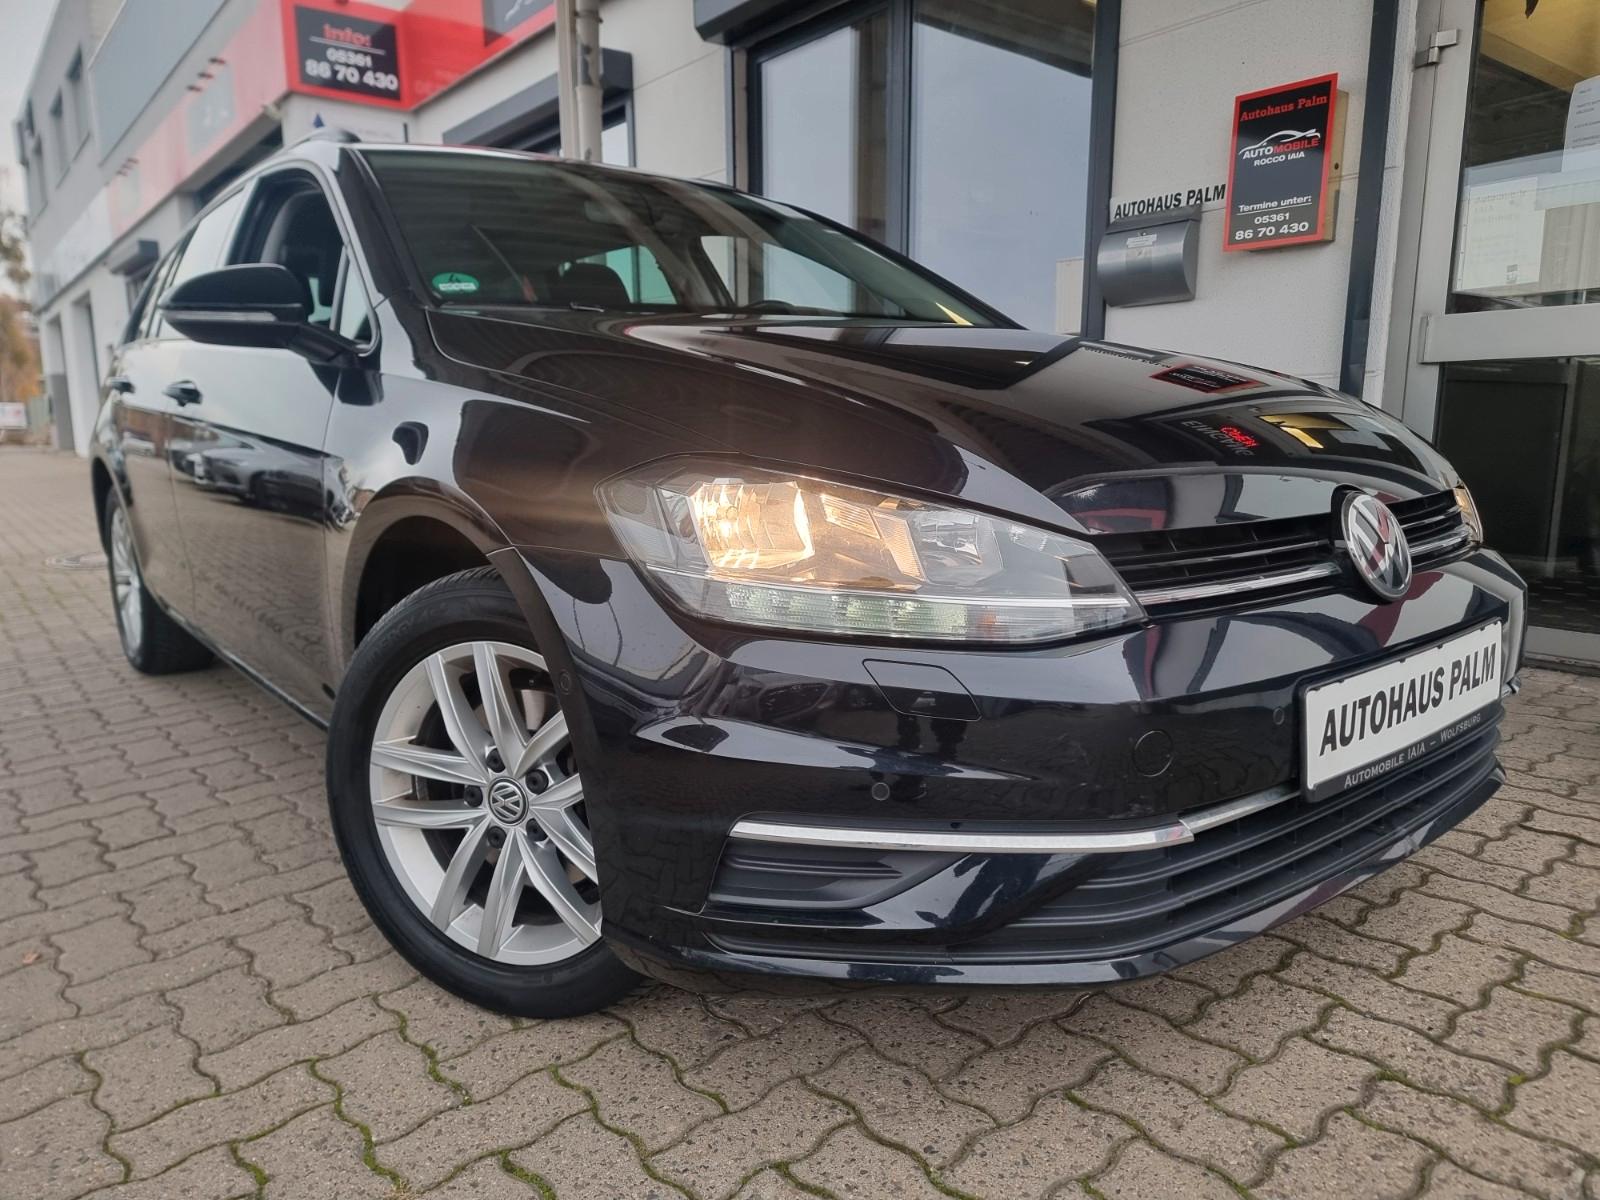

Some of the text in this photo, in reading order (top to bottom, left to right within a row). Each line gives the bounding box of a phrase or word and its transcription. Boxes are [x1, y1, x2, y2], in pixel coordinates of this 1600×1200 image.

[305, 58, 332, 79] 86
[334, 64, 361, 85] 70
[363, 70, 399, 91] 430
[1240, 95, 1328, 122] Autohaus Palm
[1242, 137, 1320, 159] AUTOMOBILE
[1254, 151, 1305, 167] ROCCO IAIA
[1114, 184, 1226, 220] AUTOHAUS PALM
[1239, 195, 1312, 213] Termine unter:
[1254, 212, 1290, 225] 05361
[1235, 222, 1309, 241] 86 70 430
[1319, 642, 1496, 757] AUTOHAUS PALM
[1344, 755, 1404, 789] AUTOMOBILE
[1407, 741, 1426, 760] IAIA
[1440, 713, 1481, 743] WOLFSBURG
